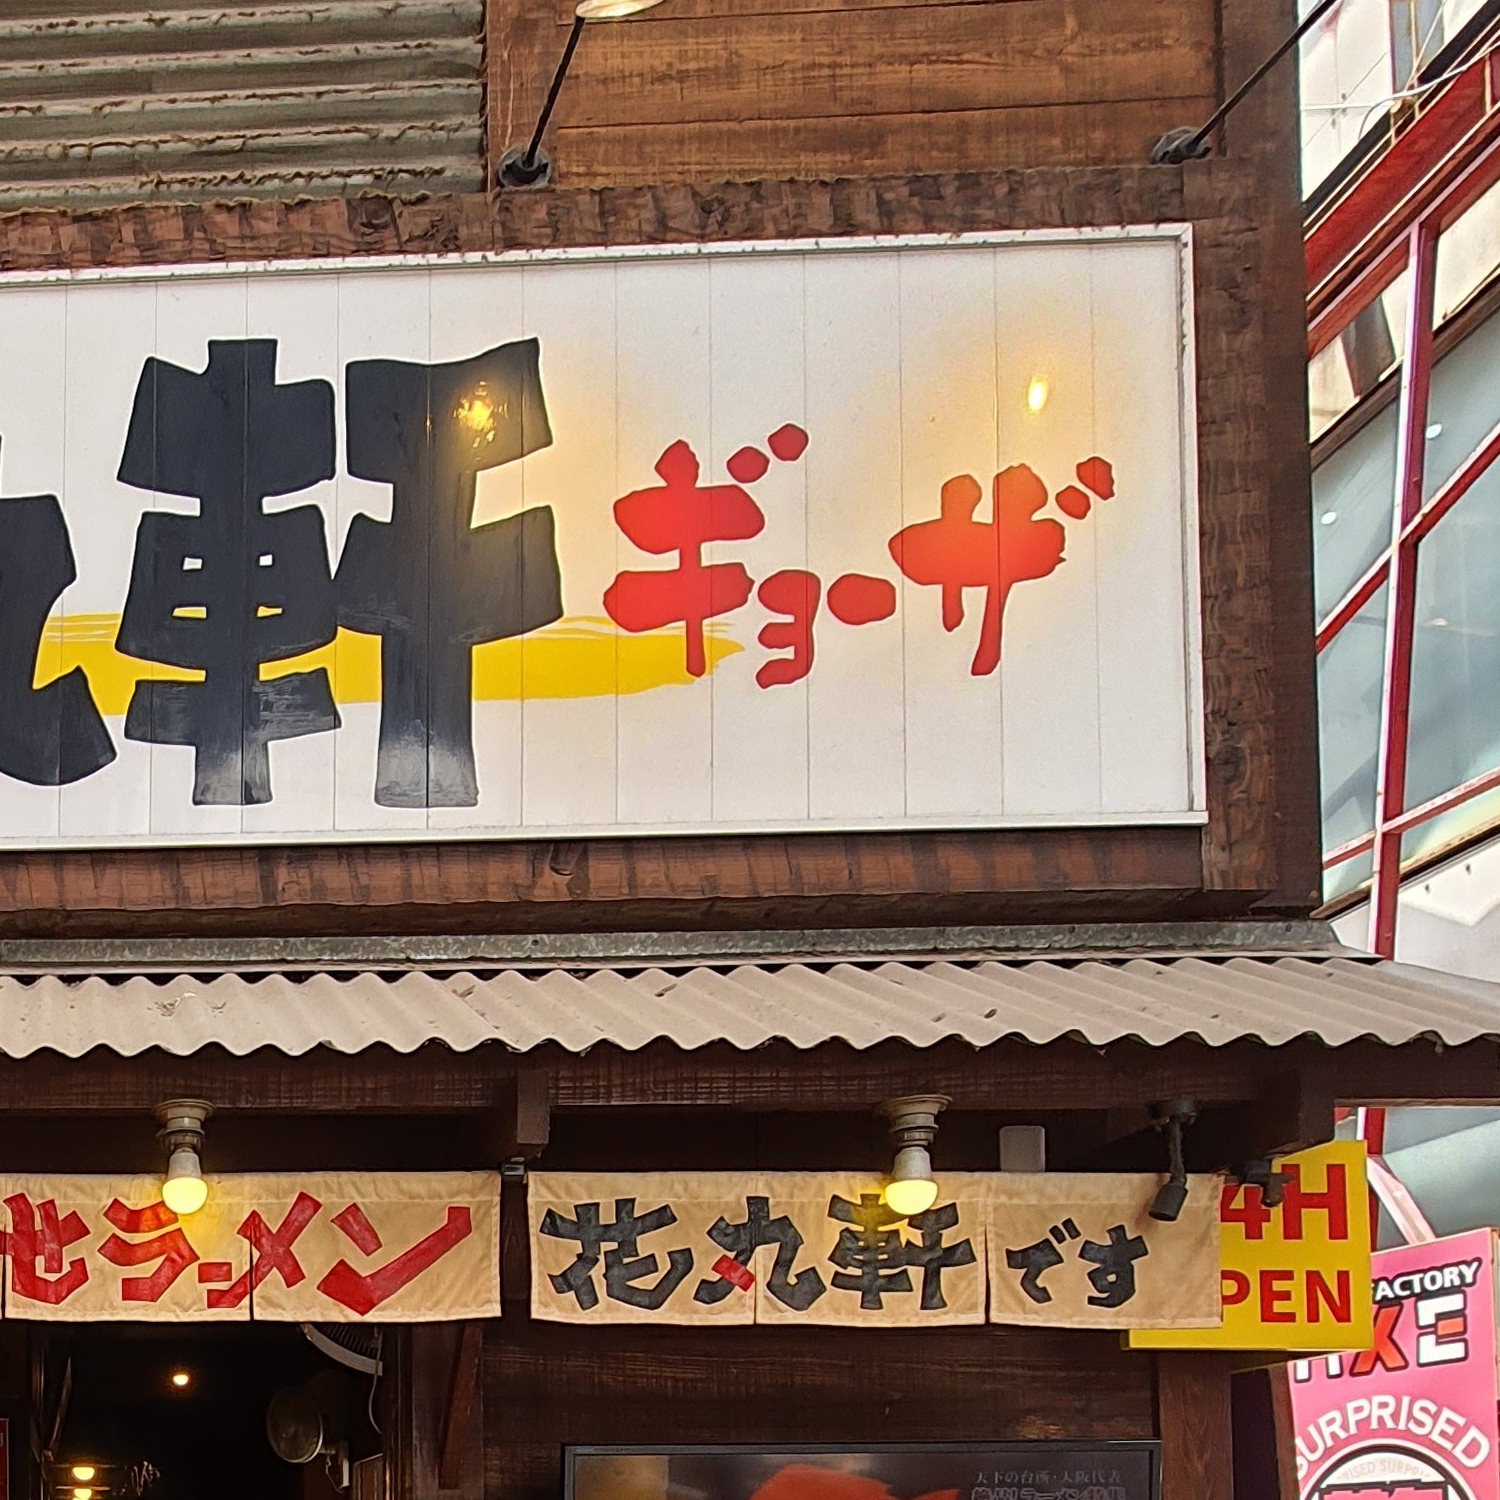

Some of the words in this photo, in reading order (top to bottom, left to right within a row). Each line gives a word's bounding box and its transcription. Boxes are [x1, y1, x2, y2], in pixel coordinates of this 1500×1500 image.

[603, 424, 1115, 685] ギョーザ
[1371, 1257, 1482, 1301] ACTORY
